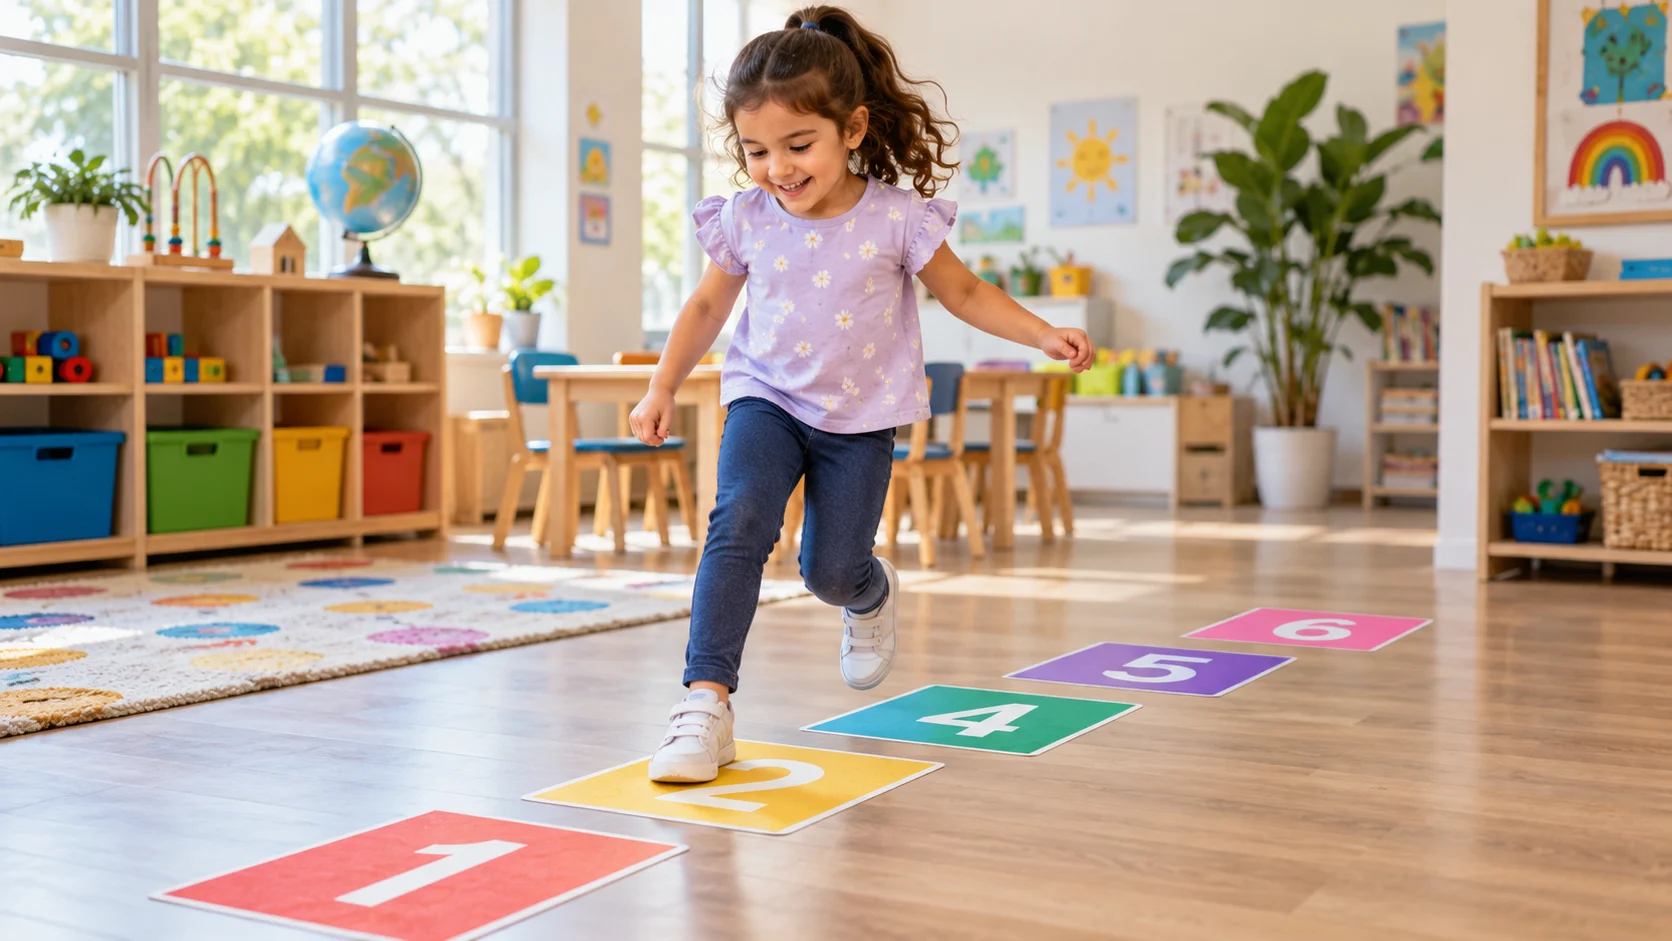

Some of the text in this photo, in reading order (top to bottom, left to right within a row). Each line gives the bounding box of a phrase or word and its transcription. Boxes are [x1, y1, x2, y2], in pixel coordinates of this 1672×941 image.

[1272, 618, 1356, 641] 6
[1102, 653, 1213, 684] 5
[917, 703, 1039, 738] 4
[655, 758, 825, 812] 2
[335, 839, 528, 907] 1
